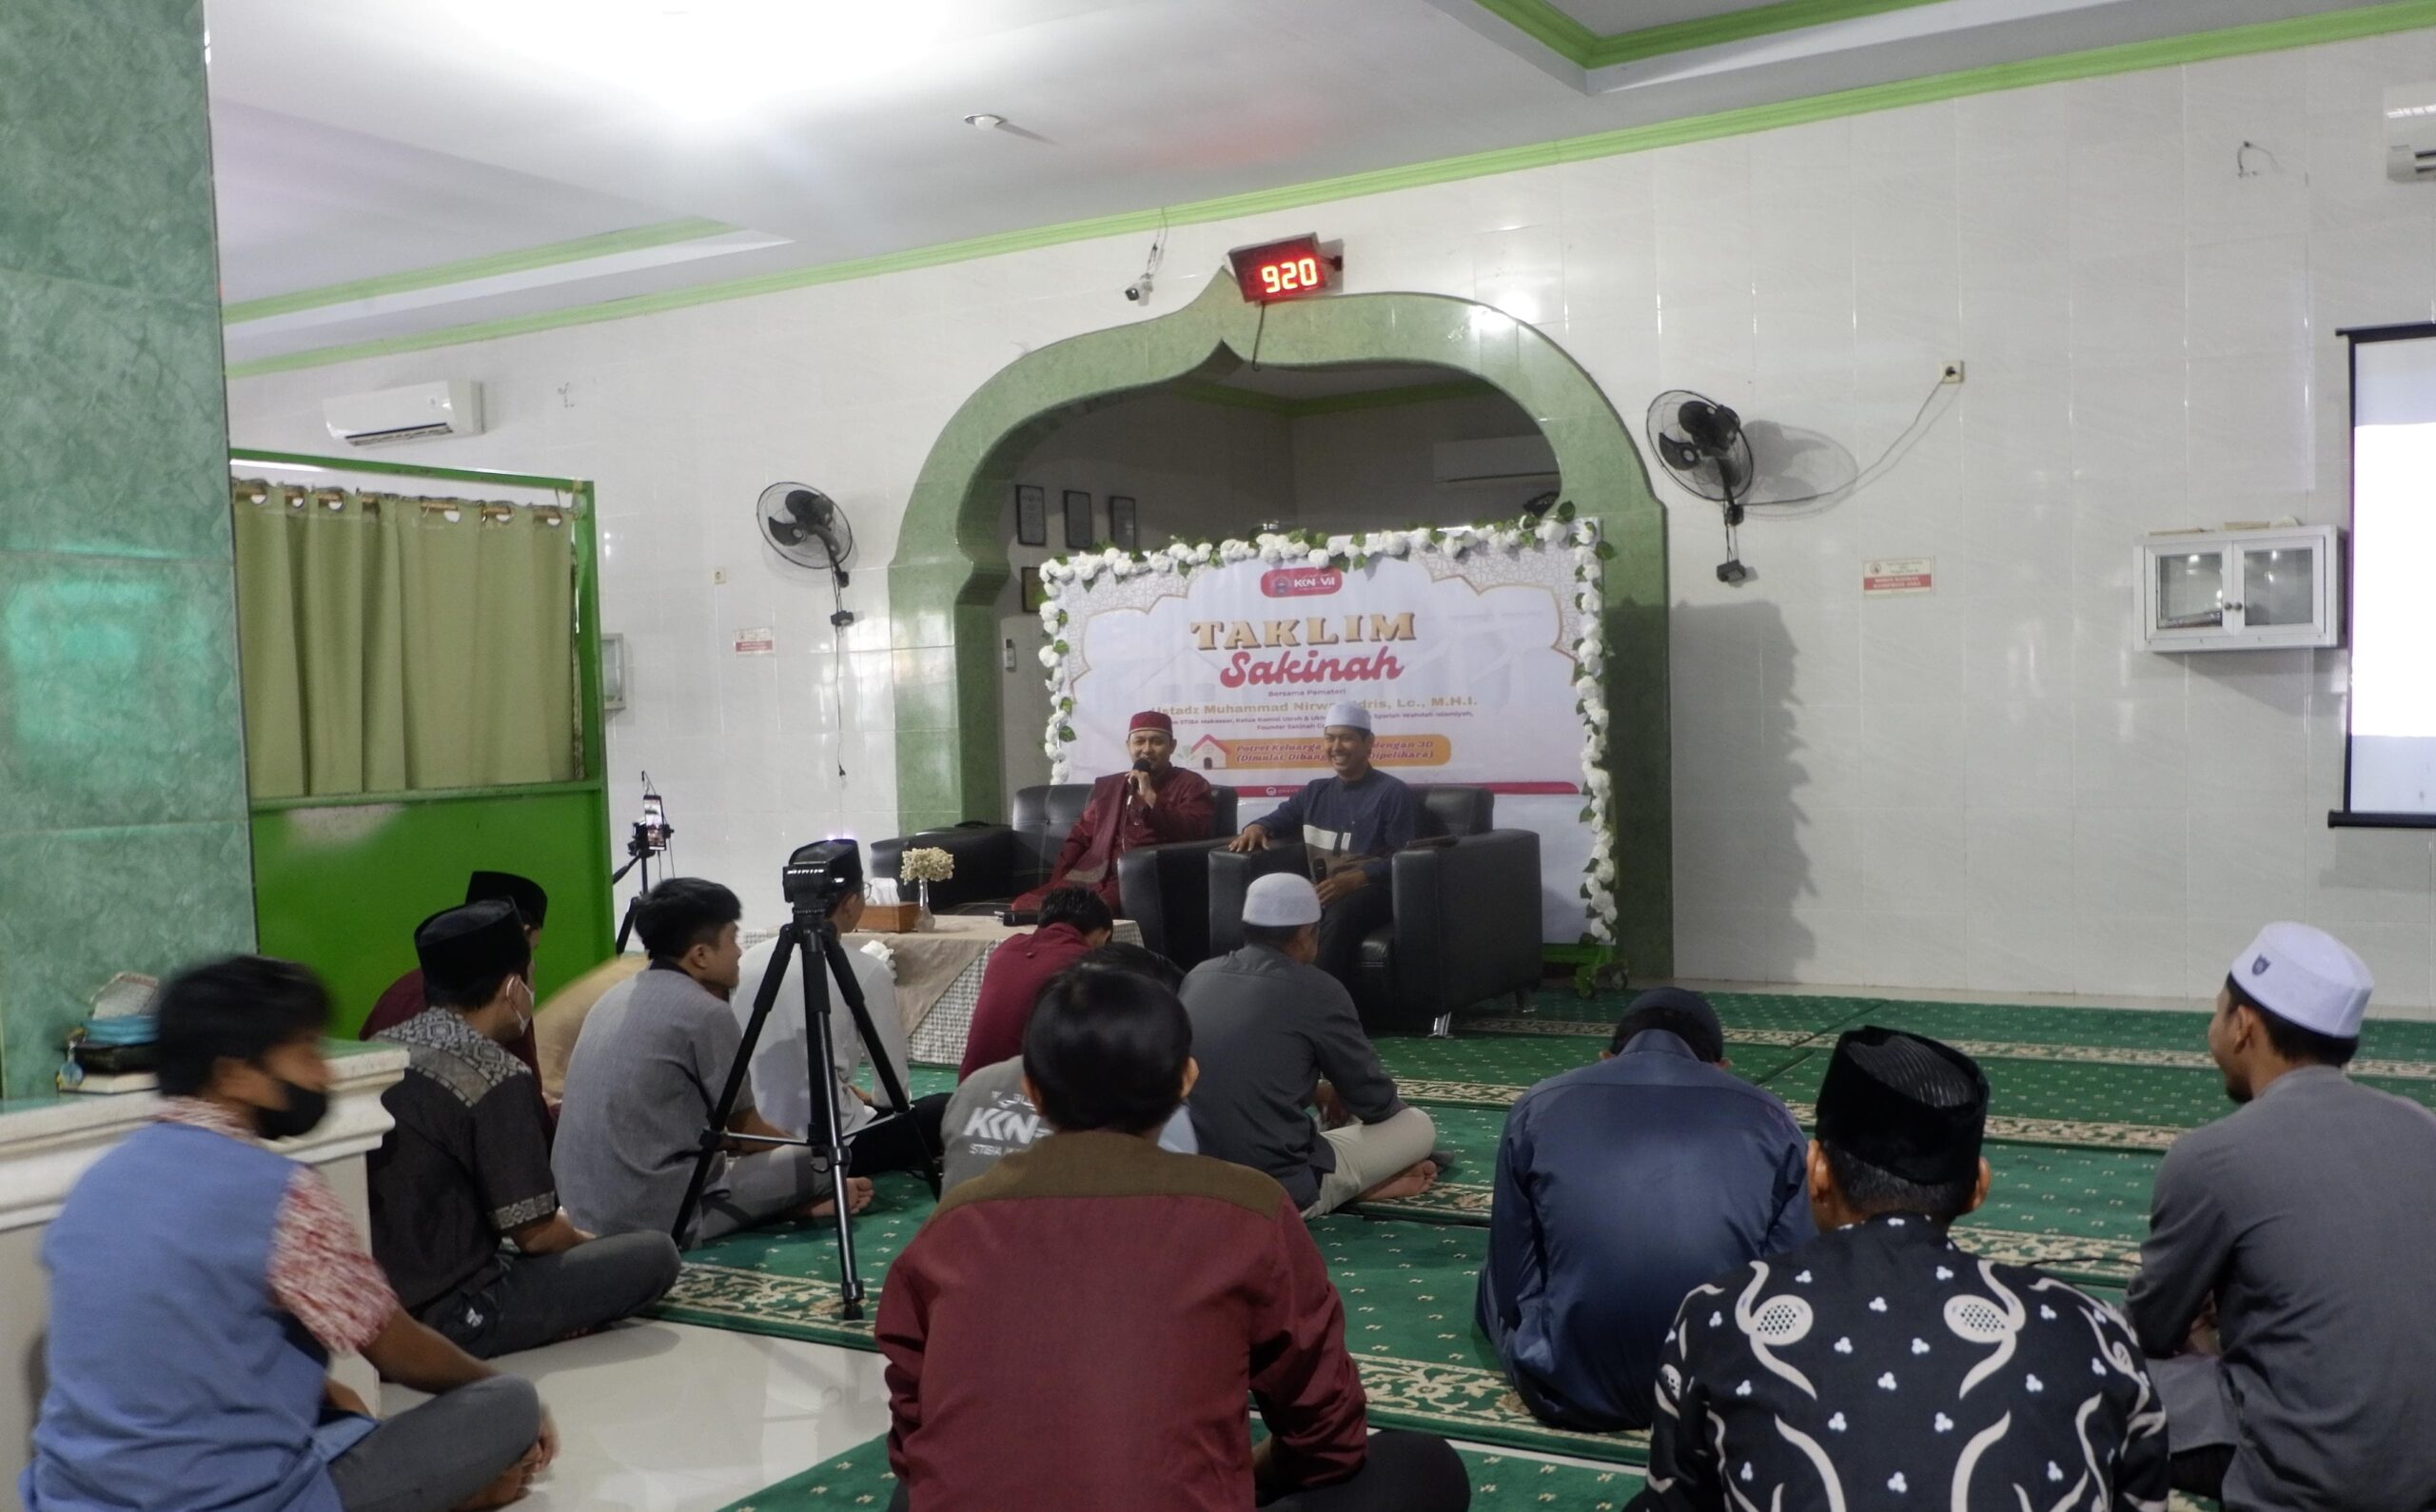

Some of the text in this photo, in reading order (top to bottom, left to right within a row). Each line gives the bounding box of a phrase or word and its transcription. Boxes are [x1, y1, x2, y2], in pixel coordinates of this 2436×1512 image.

[1261, 258, 1318, 293] 920
[1189, 612, 1417, 651] TAKLIM
[1220, 645, 1405, 688] Sakinah
[1204, 701, 1288, 715] Muhammad
[1430, 696, 1478, 708] M.H.I.
[1306, 688, 1346, 697] Pemateri
